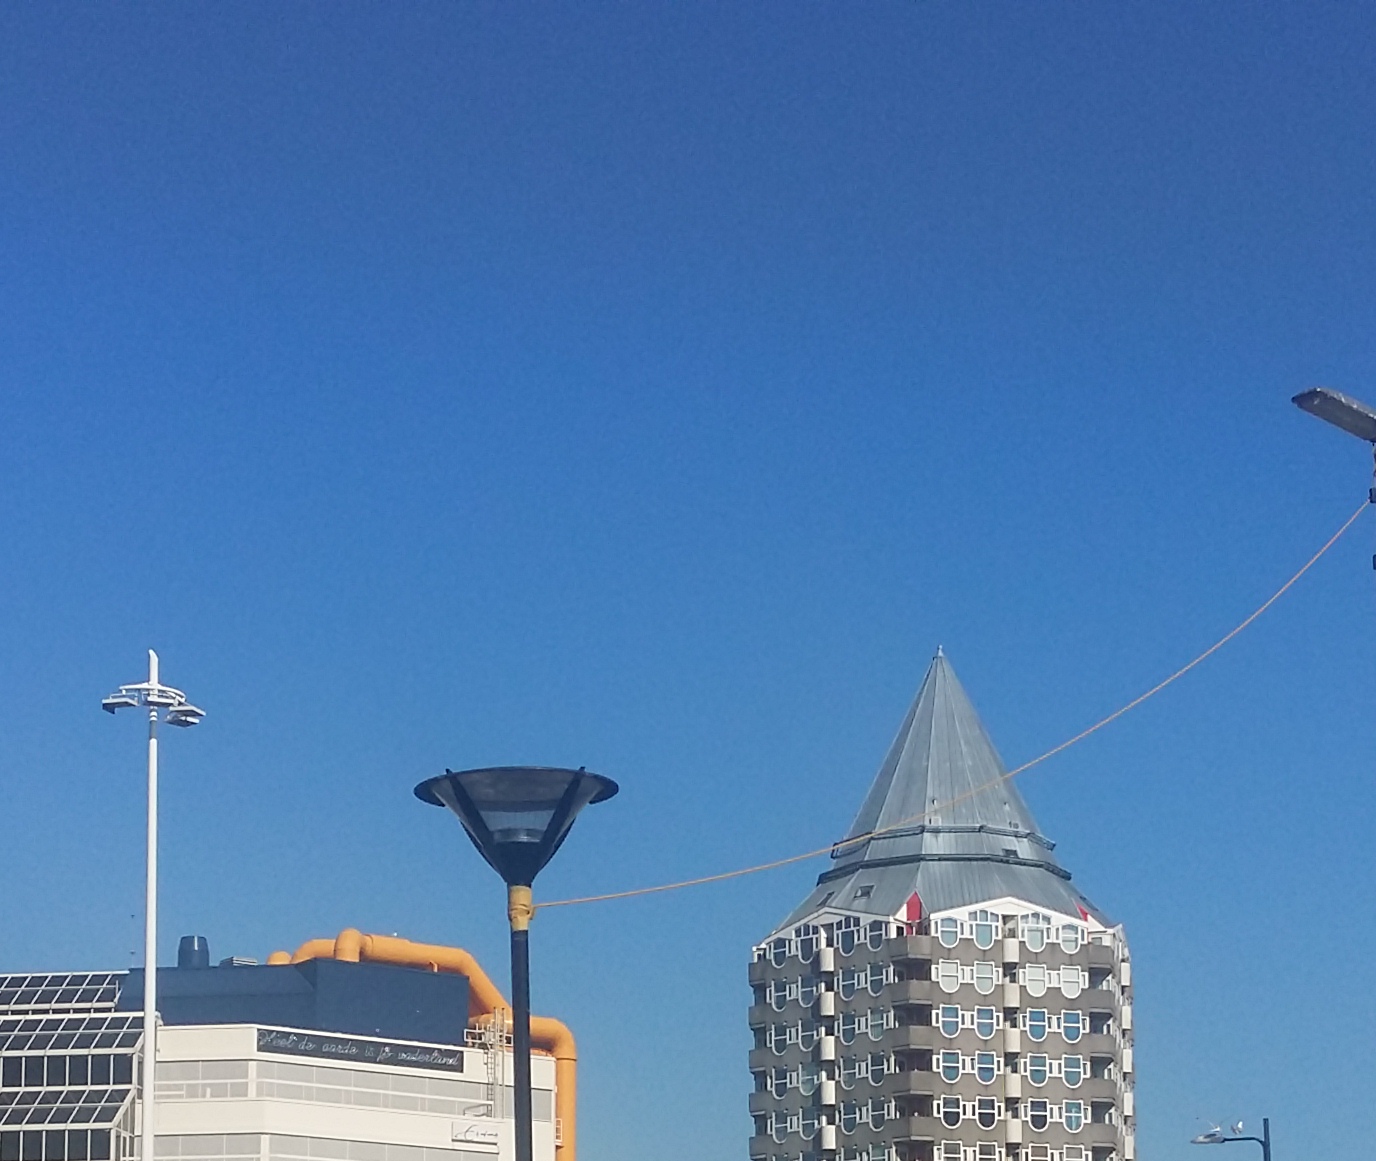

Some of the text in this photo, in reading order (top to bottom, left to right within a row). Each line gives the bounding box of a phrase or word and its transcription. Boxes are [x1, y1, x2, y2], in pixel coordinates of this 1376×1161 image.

[298, 1036, 316, 1051] de
[322, 1041, 358, 1054] aarde
[398, 1049, 460, 1066] vaderland
